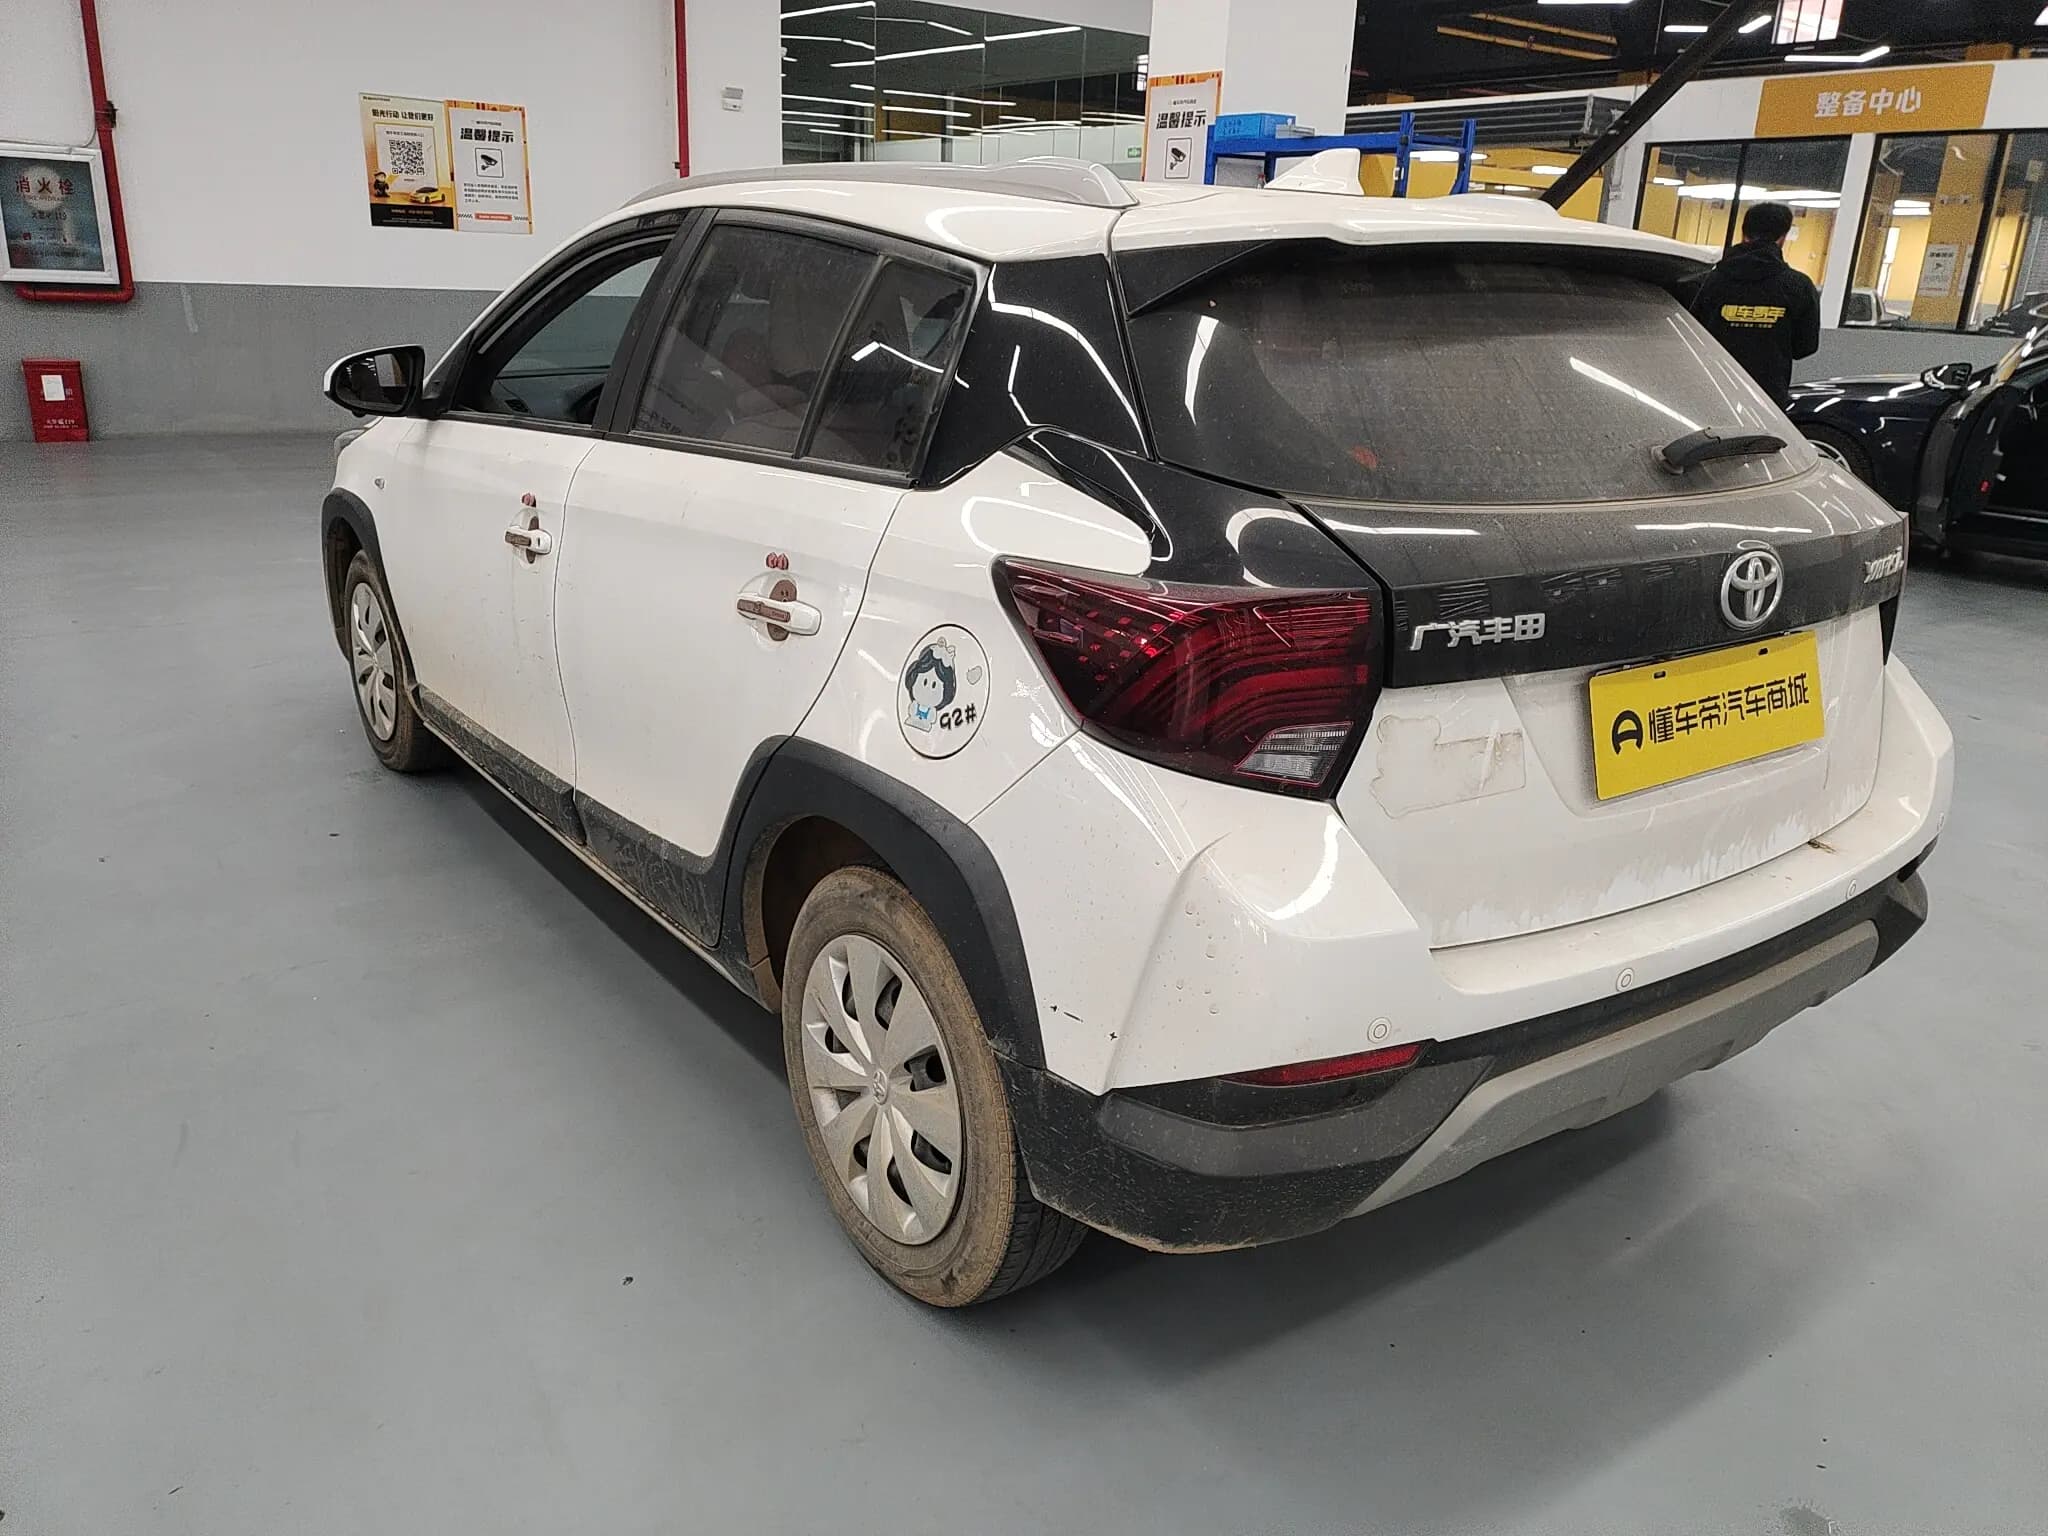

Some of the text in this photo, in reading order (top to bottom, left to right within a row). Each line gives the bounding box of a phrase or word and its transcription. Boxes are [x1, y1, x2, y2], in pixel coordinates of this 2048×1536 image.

[1815, 86, 1921, 117] 整备中心
[1156, 110, 1207, 129] 温馨提示
[460, 128, 514, 143] 温馨提示
[16, 176, 74, 195] 消火栓
[1409, 613, 1546, 651] 广汽丰田
[939, 703, 977, 730] 92#
[1649, 673, 1810, 744] 懂车帝汽车商城
